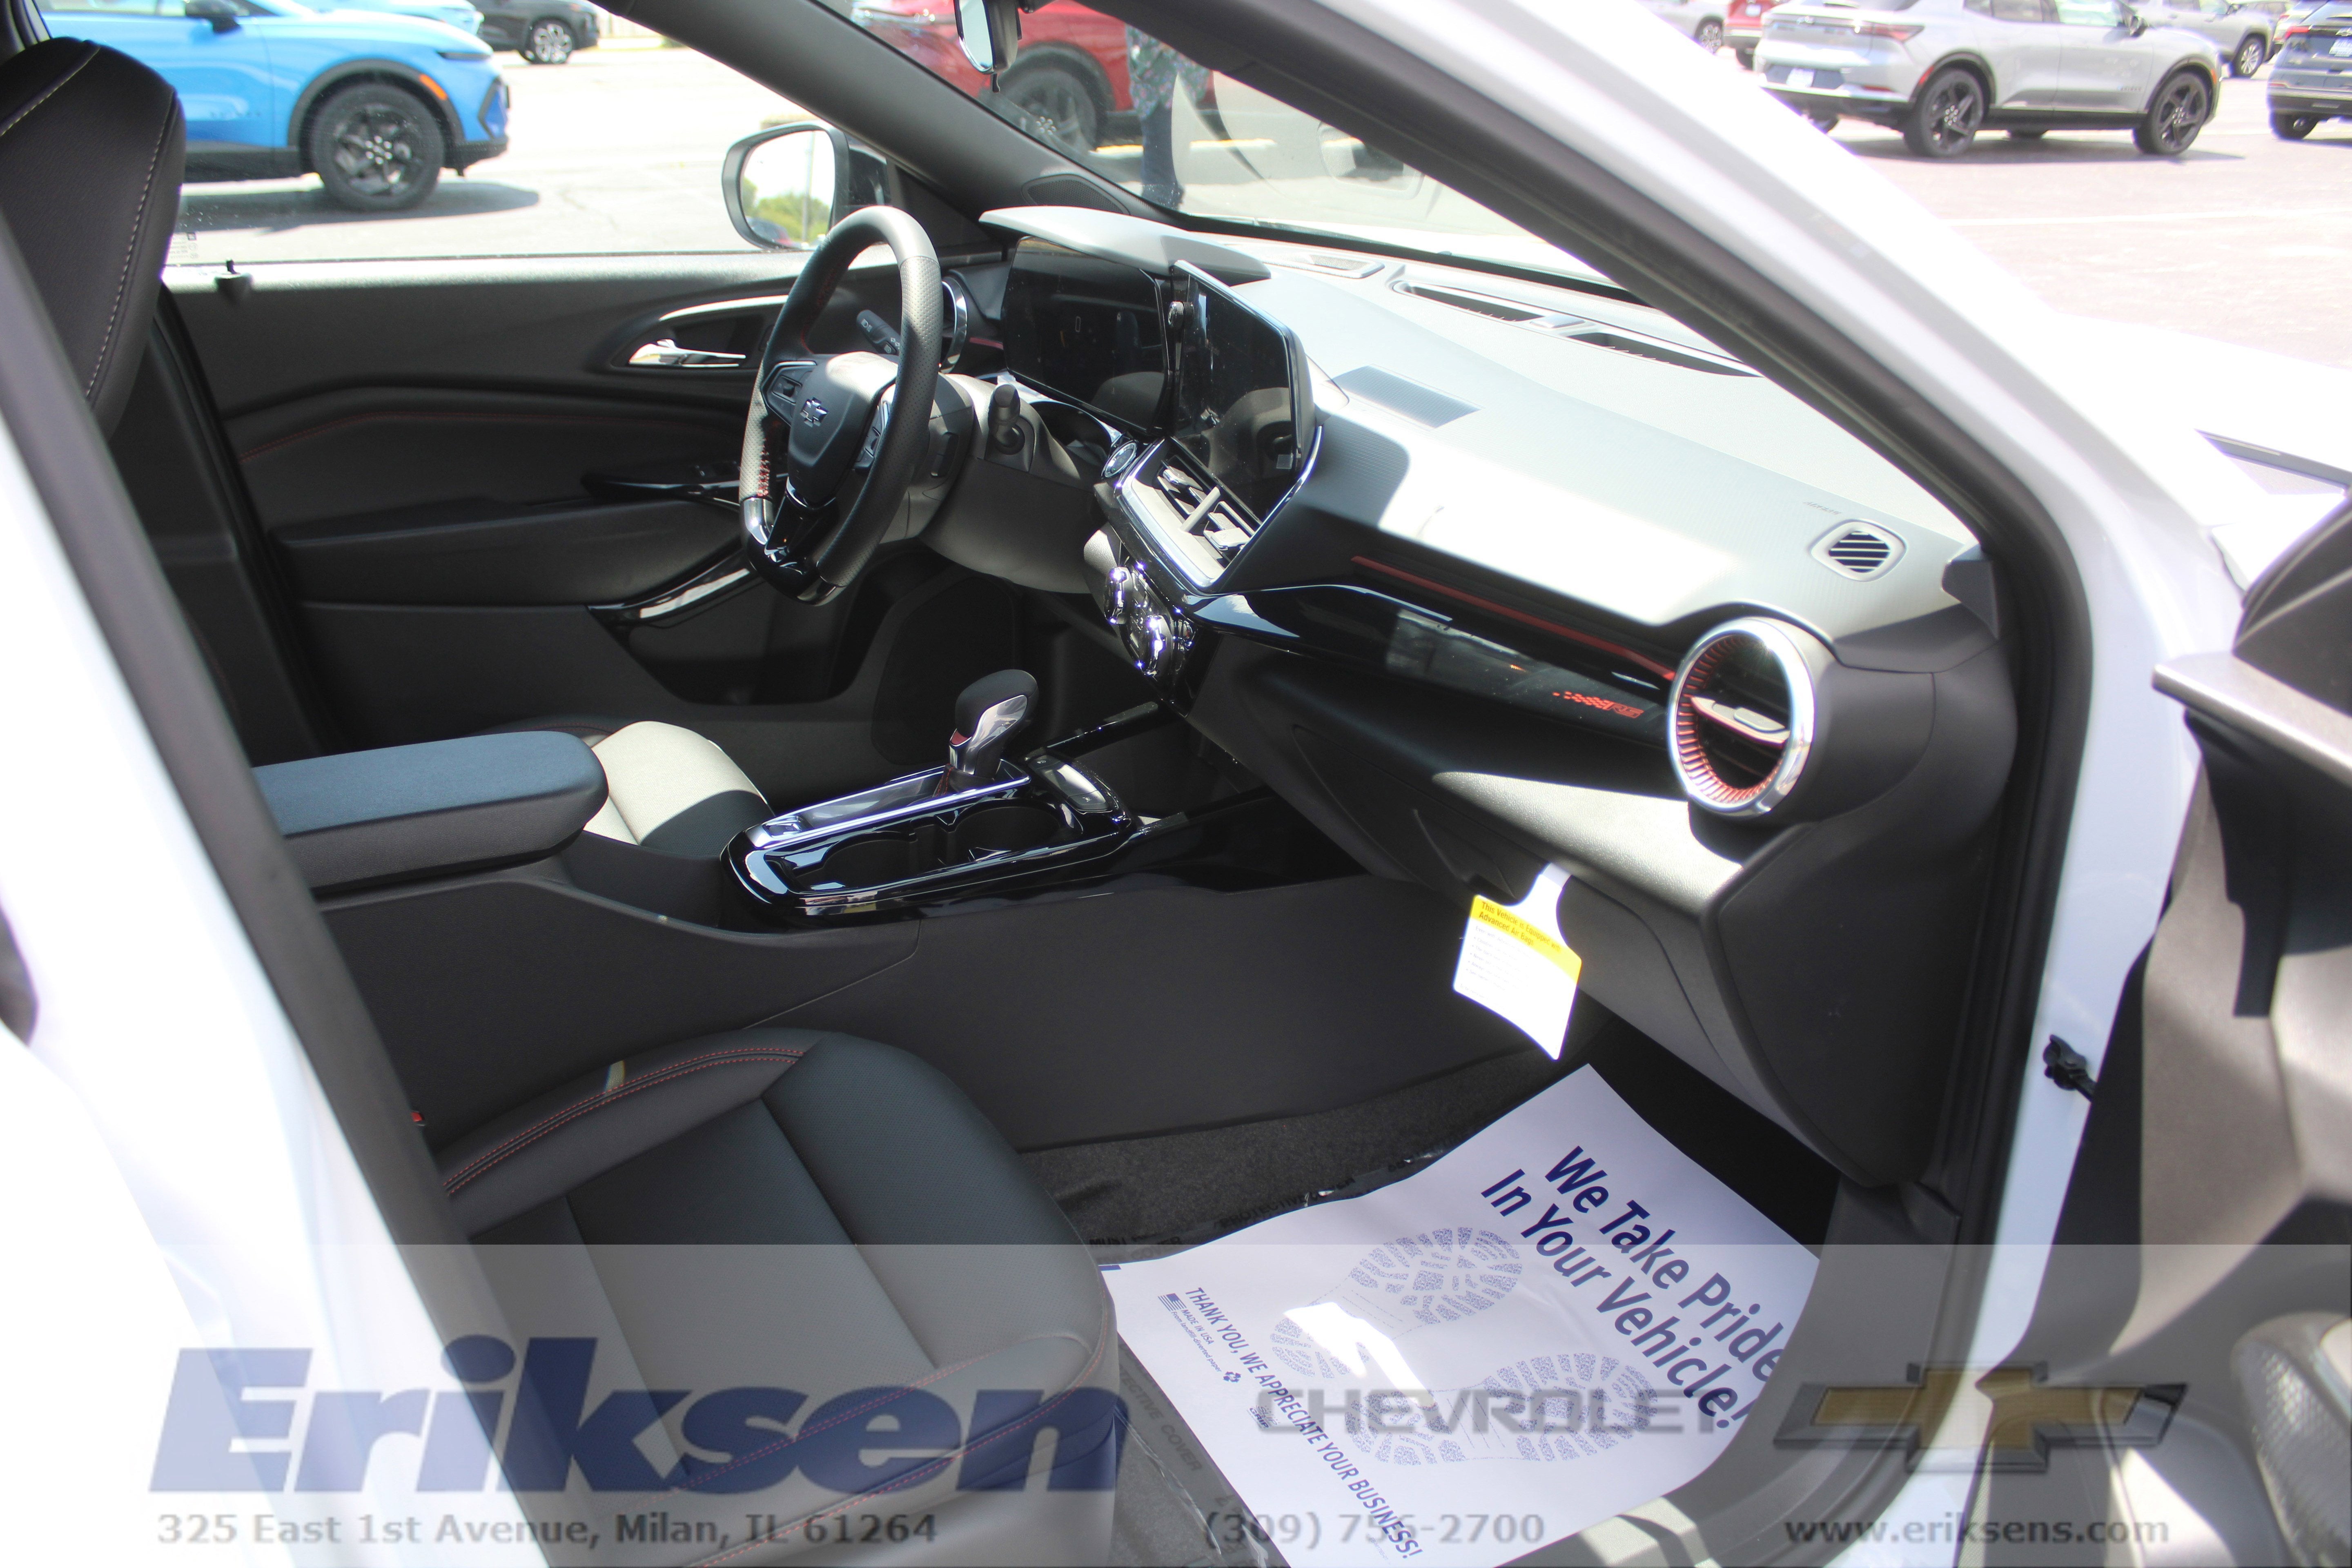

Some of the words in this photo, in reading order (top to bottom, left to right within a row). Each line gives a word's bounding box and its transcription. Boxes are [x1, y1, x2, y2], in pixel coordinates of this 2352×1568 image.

[1479, 911, 1510, 931] Advanced
[1511, 927, 1519, 936] Air
[1520, 933, 1535, 947] Bags
[1481, 901, 1495, 914] This
[1497, 908, 1518, 925] Vehicle
[1526, 924, 1551, 945] Equipped
[1545, 1145, 1608, 1213] We
[1599, 1200, 1689, 1289] Take
[1677, 1272, 1784, 1383] Pride
[1481, 1169, 1532, 1217] In
[1520, 1203, 1612, 1287] Your
[1596, 1276, 1758, 1428] Vehicle!
[1171, 1311, 1183, 1323] From
[1180, 1322, 1213, 1359] landfill-diverted
[1206, 1357, 1222, 1373] paper
[1181, 1309, 1199, 1325] MADE
[1200, 1332, 1214, 1345] USA
[1185, 1287, 1229, 1325] THANK
[1216, 1324, 1250, 1354] YOU,
[1239, 1352, 1269, 1374] WE
[1254, 1374, 1329, 1445] APPRECIATE
[1316, 1441, 1360, 1481] YOUR
[1348, 1479, 1424, 1559] BUSINESS!
[1250, 1407, 1269, 1428] GRIP
[1161, 1424, 1203, 1471] COVER
